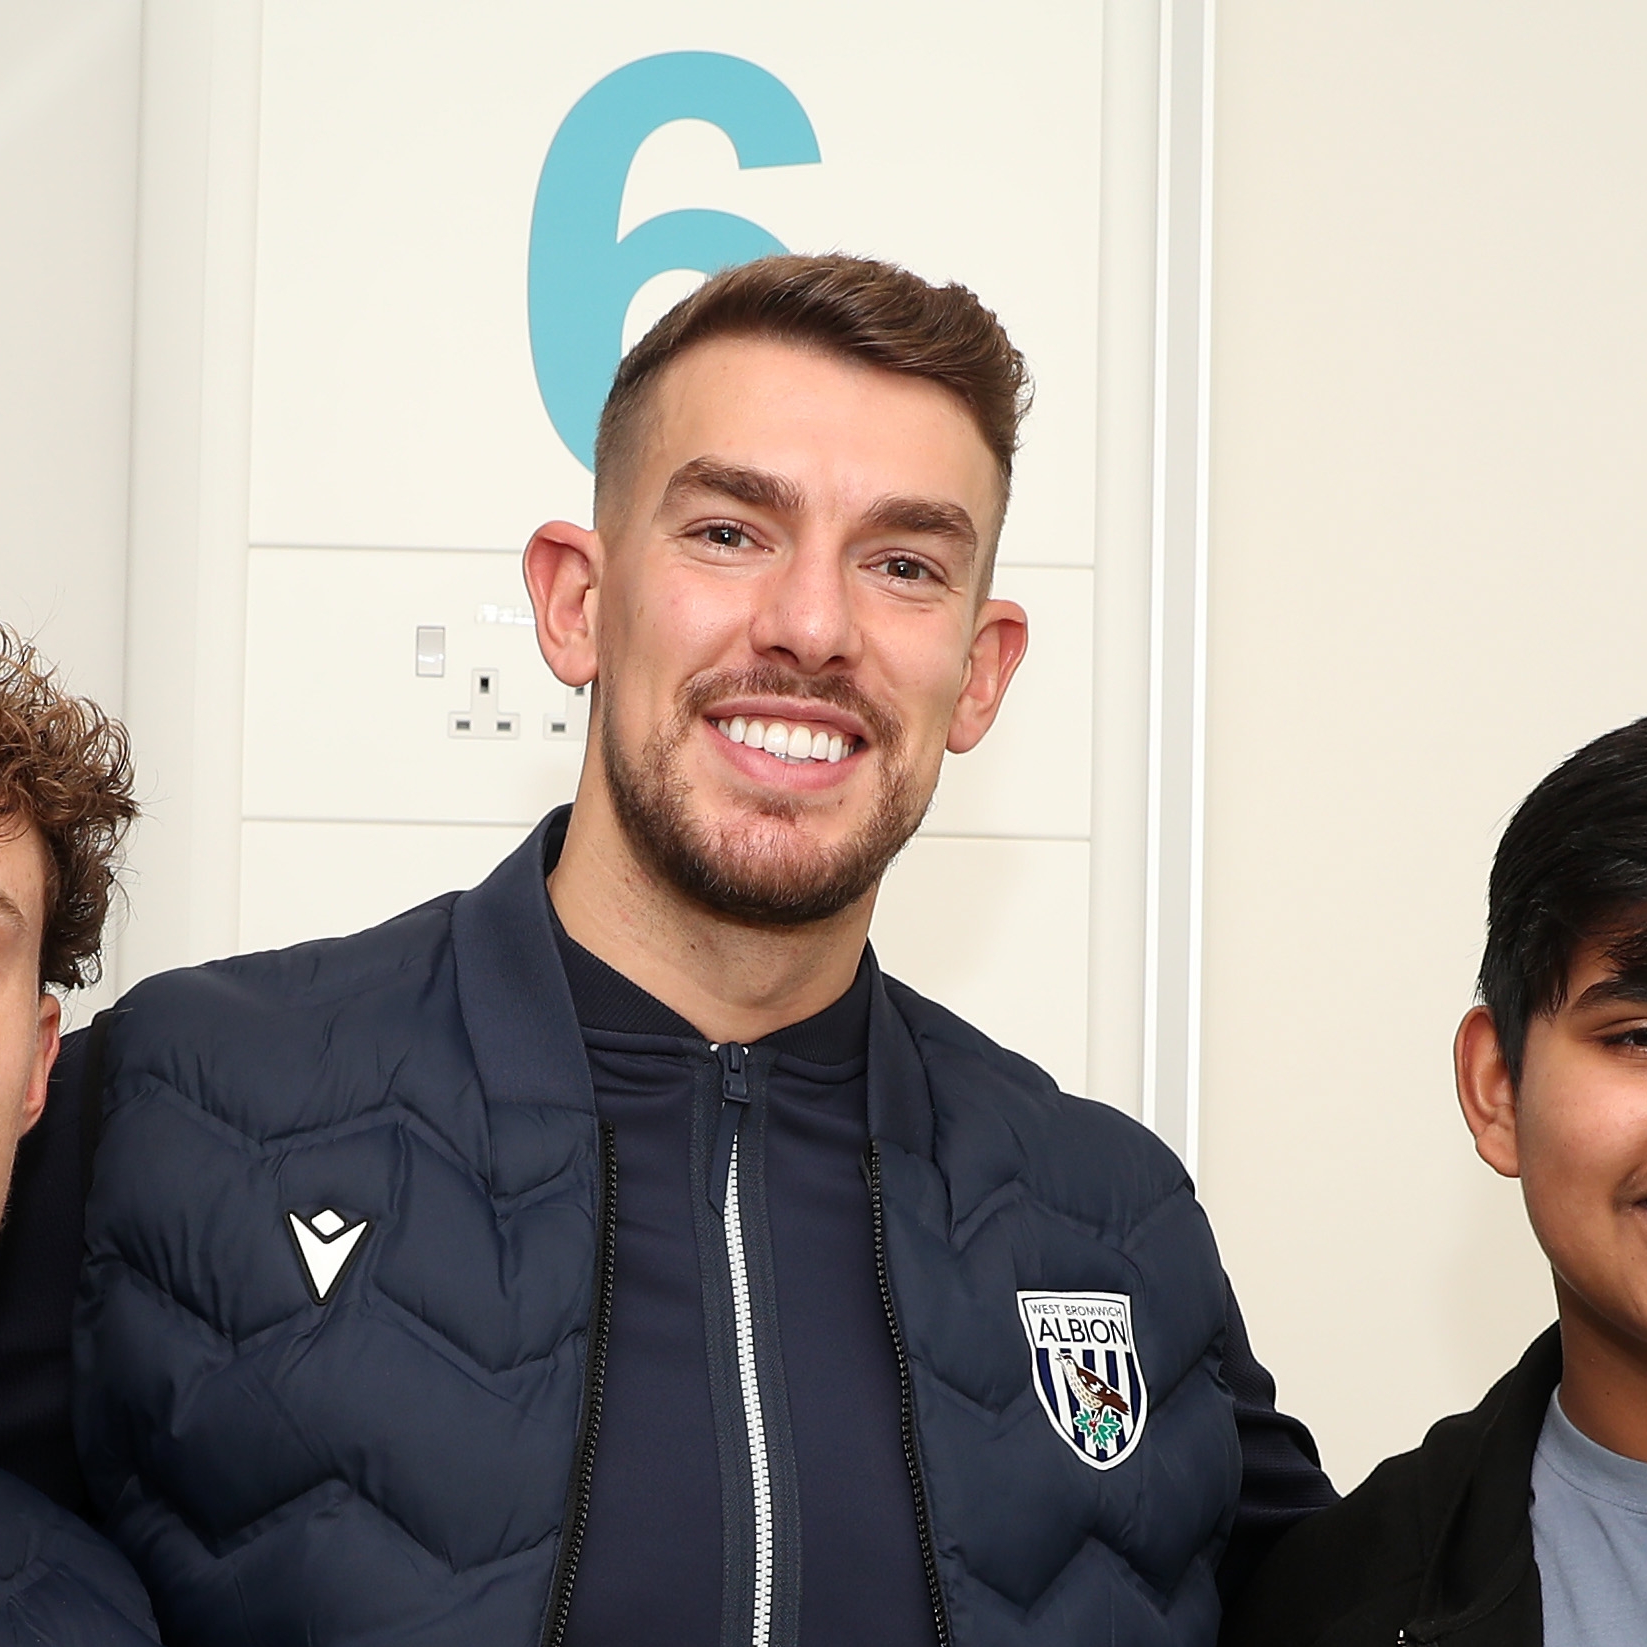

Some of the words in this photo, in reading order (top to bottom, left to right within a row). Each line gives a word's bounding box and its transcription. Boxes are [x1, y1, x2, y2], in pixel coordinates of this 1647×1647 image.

[527, 50, 821, 473] 6
[1030, 1304, 1061, 1315] WEST
[1064, 1305, 1123, 1318] BROMWICH
[1039, 1317, 1127, 1346] ALBION
